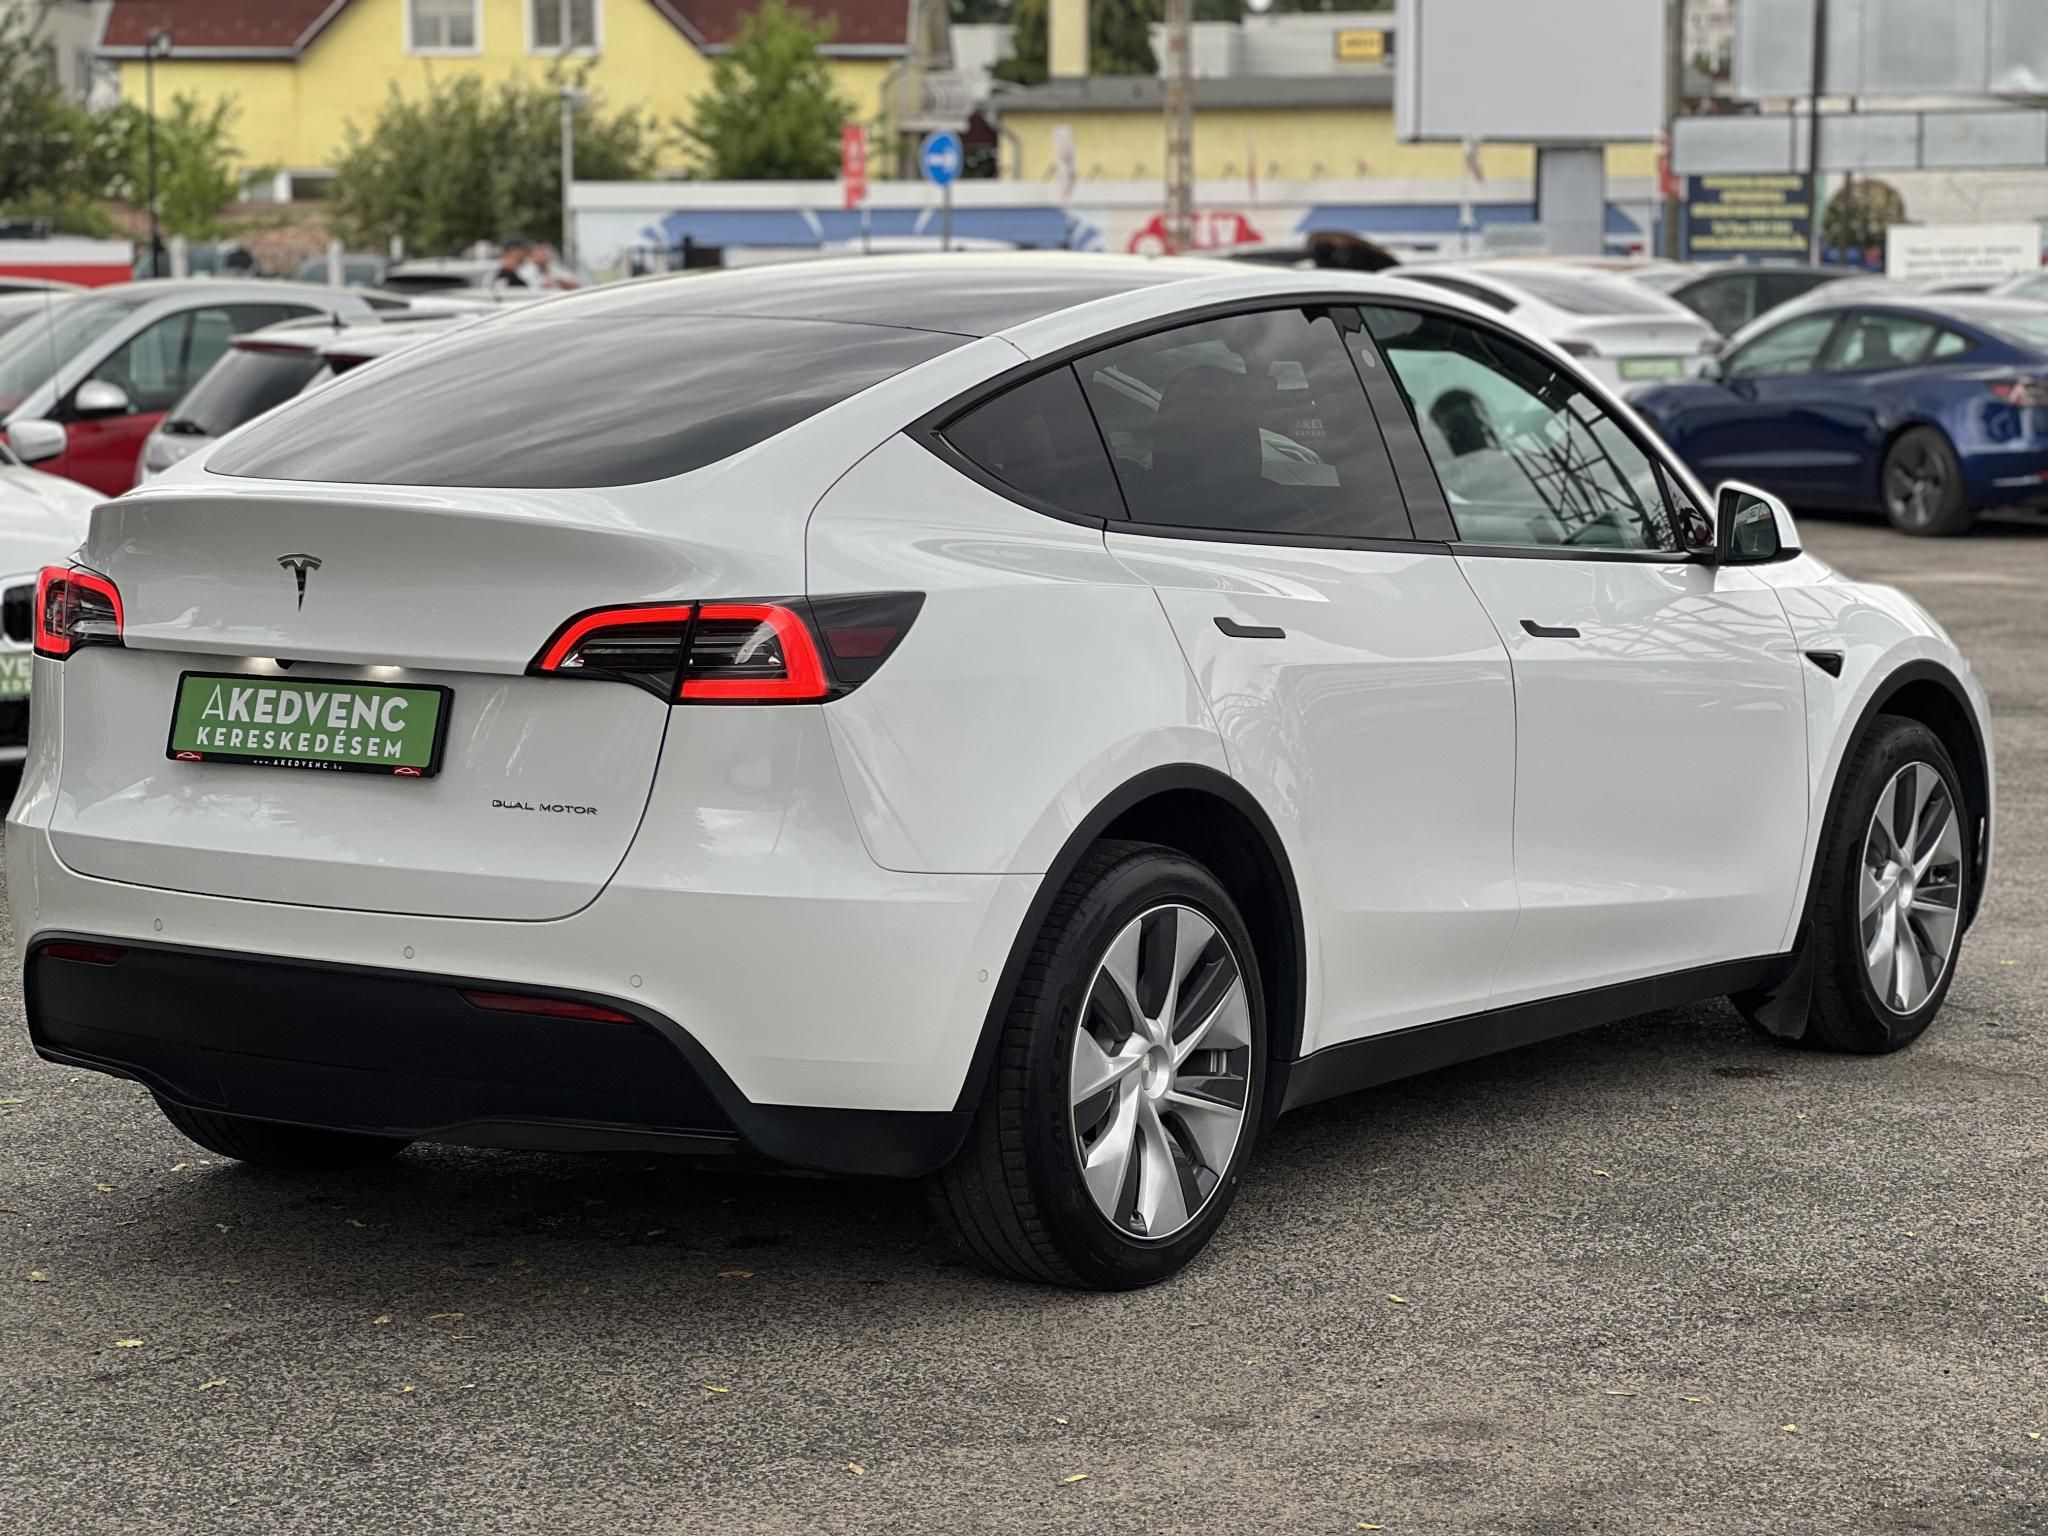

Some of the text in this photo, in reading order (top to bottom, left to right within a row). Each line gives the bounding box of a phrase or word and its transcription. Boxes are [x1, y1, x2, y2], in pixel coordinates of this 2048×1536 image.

[201, 683, 409, 733] AKEDVENC
[196, 726, 402, 759] KERESKEDÉSEM
[492, 799, 598, 815] DUAL MOTOR
